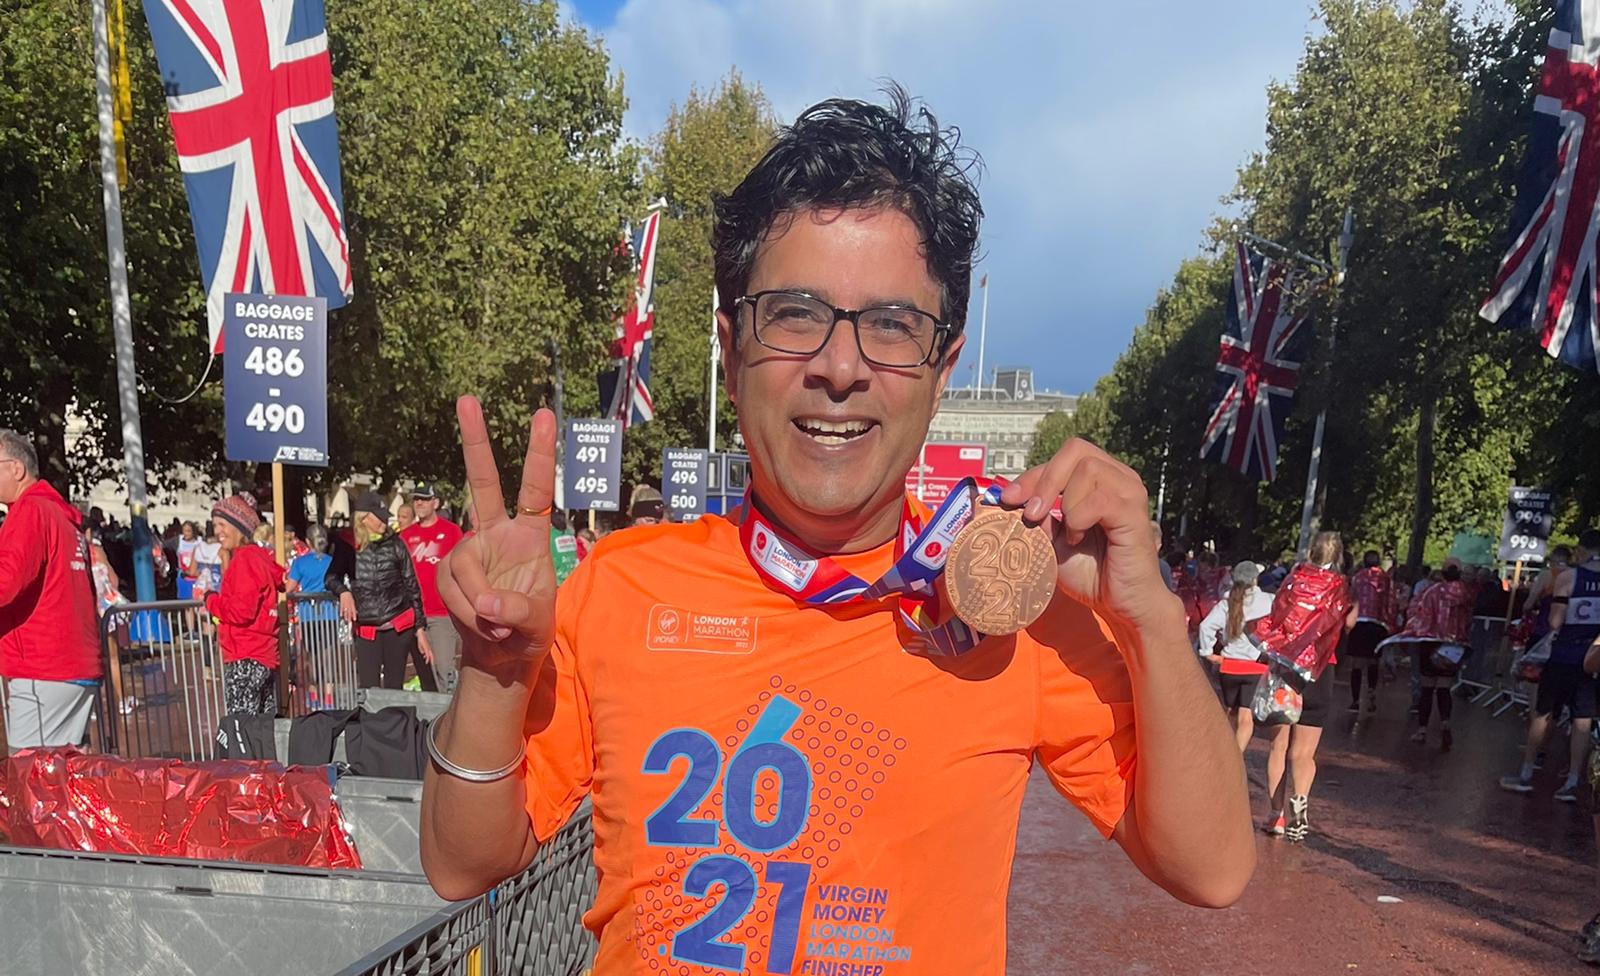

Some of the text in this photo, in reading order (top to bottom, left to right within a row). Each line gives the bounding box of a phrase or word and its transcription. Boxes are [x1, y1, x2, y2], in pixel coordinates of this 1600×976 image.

[235, 302, 314, 321] BAGGAGE
[244, 323, 304, 341] CRATES
[244, 346, 304, 377] 486
[245, 403, 305, 434] 490
[572, 423, 616, 434] BAGGAGE
[577, 434, 610, 444] CRATES
[576, 447, 607, 464] 491
[668, 451, 702, 460] BAGGAGE
[672, 461, 698, 469] CRATES
[574, 477, 608, 494] 495
[671, 470, 698, 484] 496
[671, 495, 697, 508] 500
[944, 503, 969, 533] LONDON
[1515, 510, 1542, 524] 996
[771, 553, 806, 578] MARATHON
[774, 547, 802, 568] LONDON
[694, 615, 737, 626] LONDON
[693, 625, 750, 638] MARATHON
[818, 885, 888, 904] VIRGIN
[813, 903, 886, 924] MONEY
[810, 923, 894, 943] LONDON
[806, 941, 912, 961] MARATHON
[801, 960, 883, 976] FINISHER
